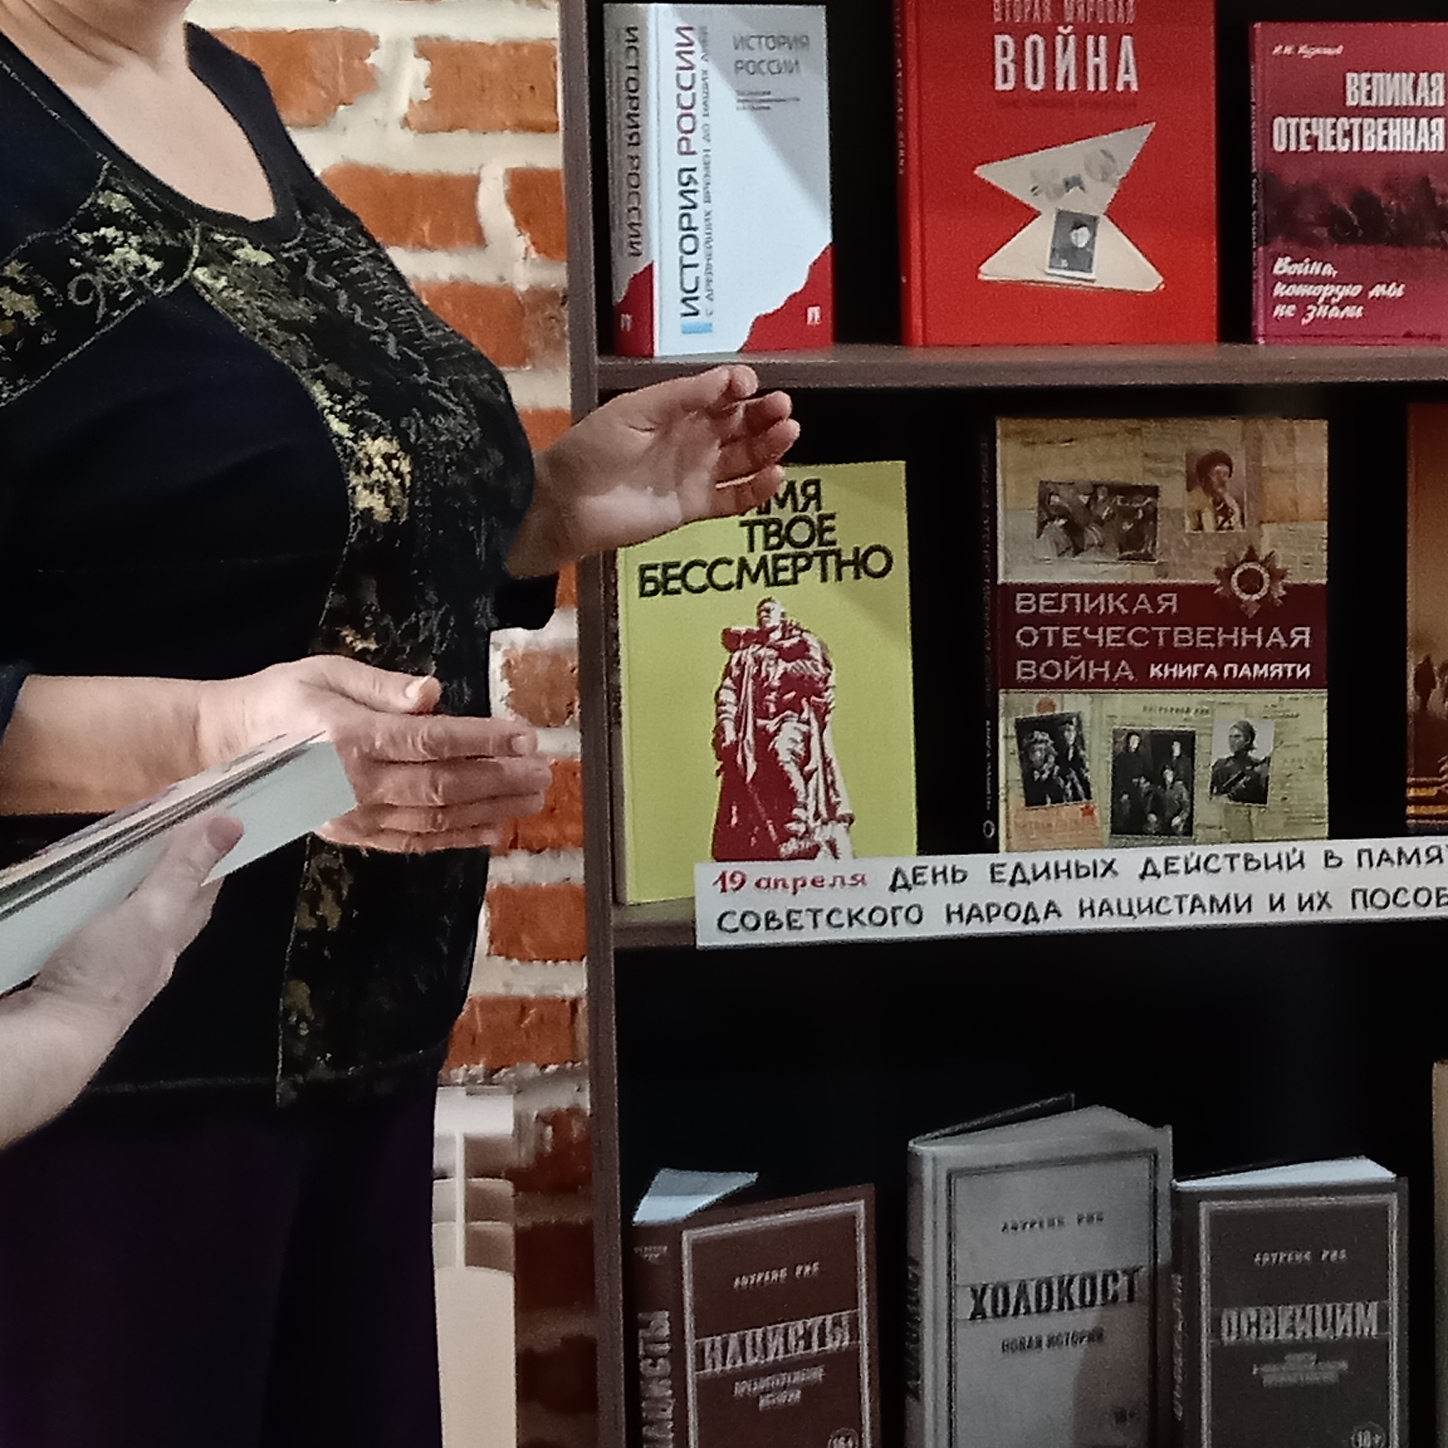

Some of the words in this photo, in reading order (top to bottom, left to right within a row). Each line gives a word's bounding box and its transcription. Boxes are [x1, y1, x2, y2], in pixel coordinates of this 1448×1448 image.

[733, 33, 810, 51] ИСТОРИЯ
[994, 25, 1138, 92] ВОЙНА
[734, 59, 801, 75] РОССИИ
[623, 26, 640, 149] ИСТОРИЯ
[674, 25, 698, 158] РОССИИ
[1346, 72, 1445, 107] ВЕЛИКАЯ
[1272, 117, 1445, 152] ОТЕЧЕСТВЕННАЯ
[626, 155, 643, 258] РОССИИ
[677, 166, 701, 318] ИСТОРИЯ
[1273, 257, 1338, 277] Война,
[1273, 283, 1362, 305] которую
[1369, 284, 1405, 299] мы
[1273, 304, 1295, 318] не
[1302, 304, 1364, 324] знали
[739, 513, 837, 552] ТВОЕ
[638, 542, 894, 599] БЕССМЕРТНО
[1015, 591, 1179, 616] ВЕЛИКАЯ
[1015, 626, 1312, 650] ОТЕЧЕСТВЕННАЯ
[1016, 655, 1135, 683] ВОЙНА
[1149, 662, 1219, 680] КНИГА
[1223, 661, 1312, 680] ПАМЯТИ
[712, 872, 748, 894] 19
[755, 872, 868, 896] апреля
[889, 865, 969, 892] ДЕНЬ
[990, 859, 1120, 887] ЕДИНЫХ
[1138, 846, 1306, 880] ДЕЙСТВИЙ
[1323, 848, 1344, 870] В
[717, 904, 923, 934] СОВЕТСКОГО
[946, 897, 1062, 925] НАРОДА
[1079, 892, 1253, 923] НАЦИСТАМИ
[1269, 893, 1288, 915] И
[1297, 891, 1333, 913] ИХ
[969, 1265, 1144, 1321] ХОЛОКОСТ
[1001, 1333, 1043, 1353] НОВАЯ
[1046, 1328, 1104, 1349] ИСТОРИЯ
[1220, 1301, 1378, 1343] ОСВЕНЦИМ
[704, 1314, 850, 1370] НАЦИСТЫ
